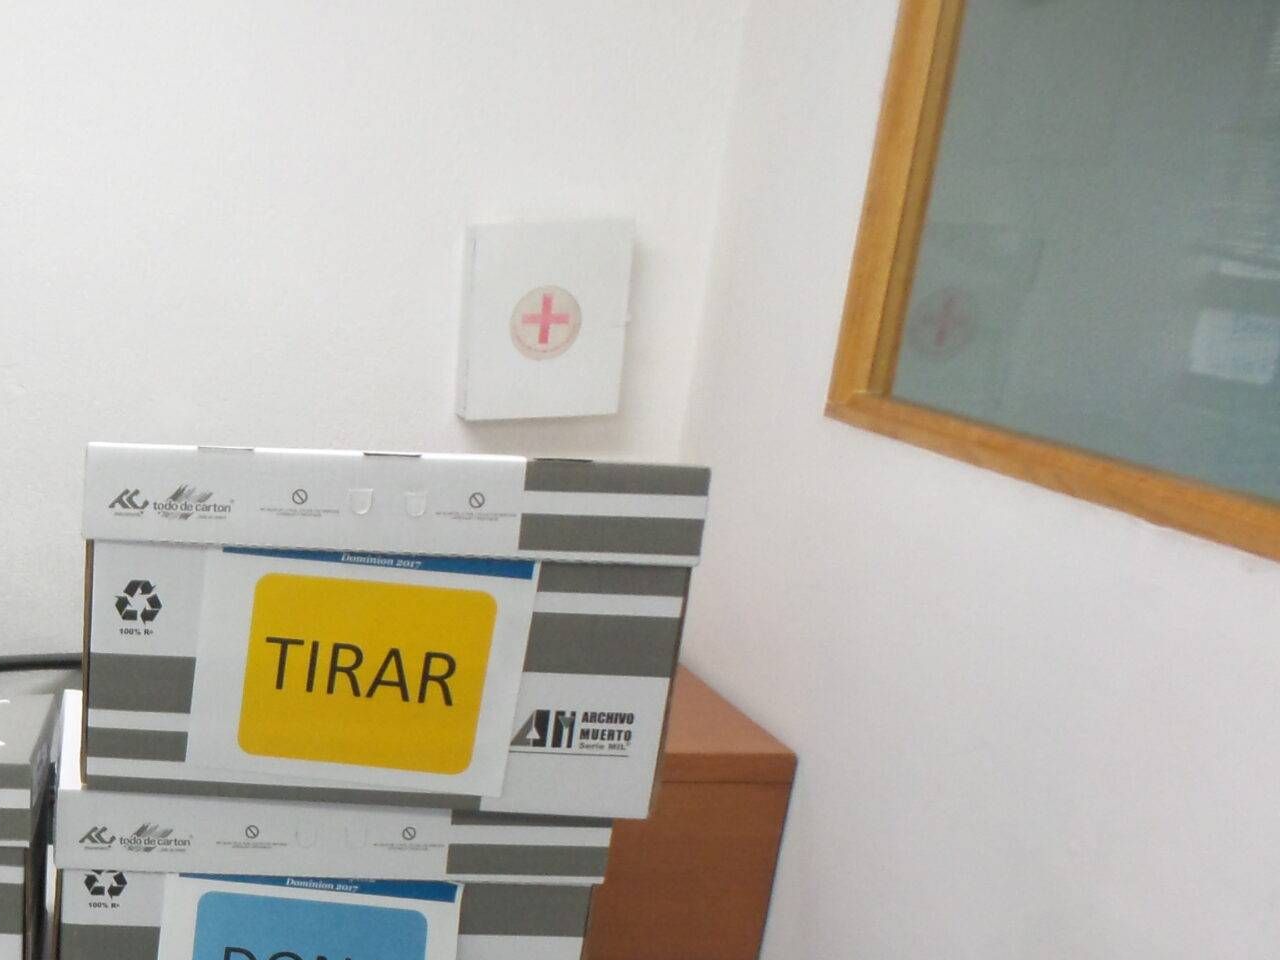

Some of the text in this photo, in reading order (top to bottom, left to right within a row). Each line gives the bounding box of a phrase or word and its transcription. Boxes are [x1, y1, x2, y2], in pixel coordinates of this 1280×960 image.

[153, 500, 179, 511] todo
[180, 501, 193, 511] de
[266, 637, 456, 706] TIRAR
[581, 711, 634, 725] ARCHIVO
[580, 728, 632, 741] MUERTO
[120, 836, 142, 846] todo
[143, 836, 156, 846] de
[286, 878, 334, 890] Dominion
